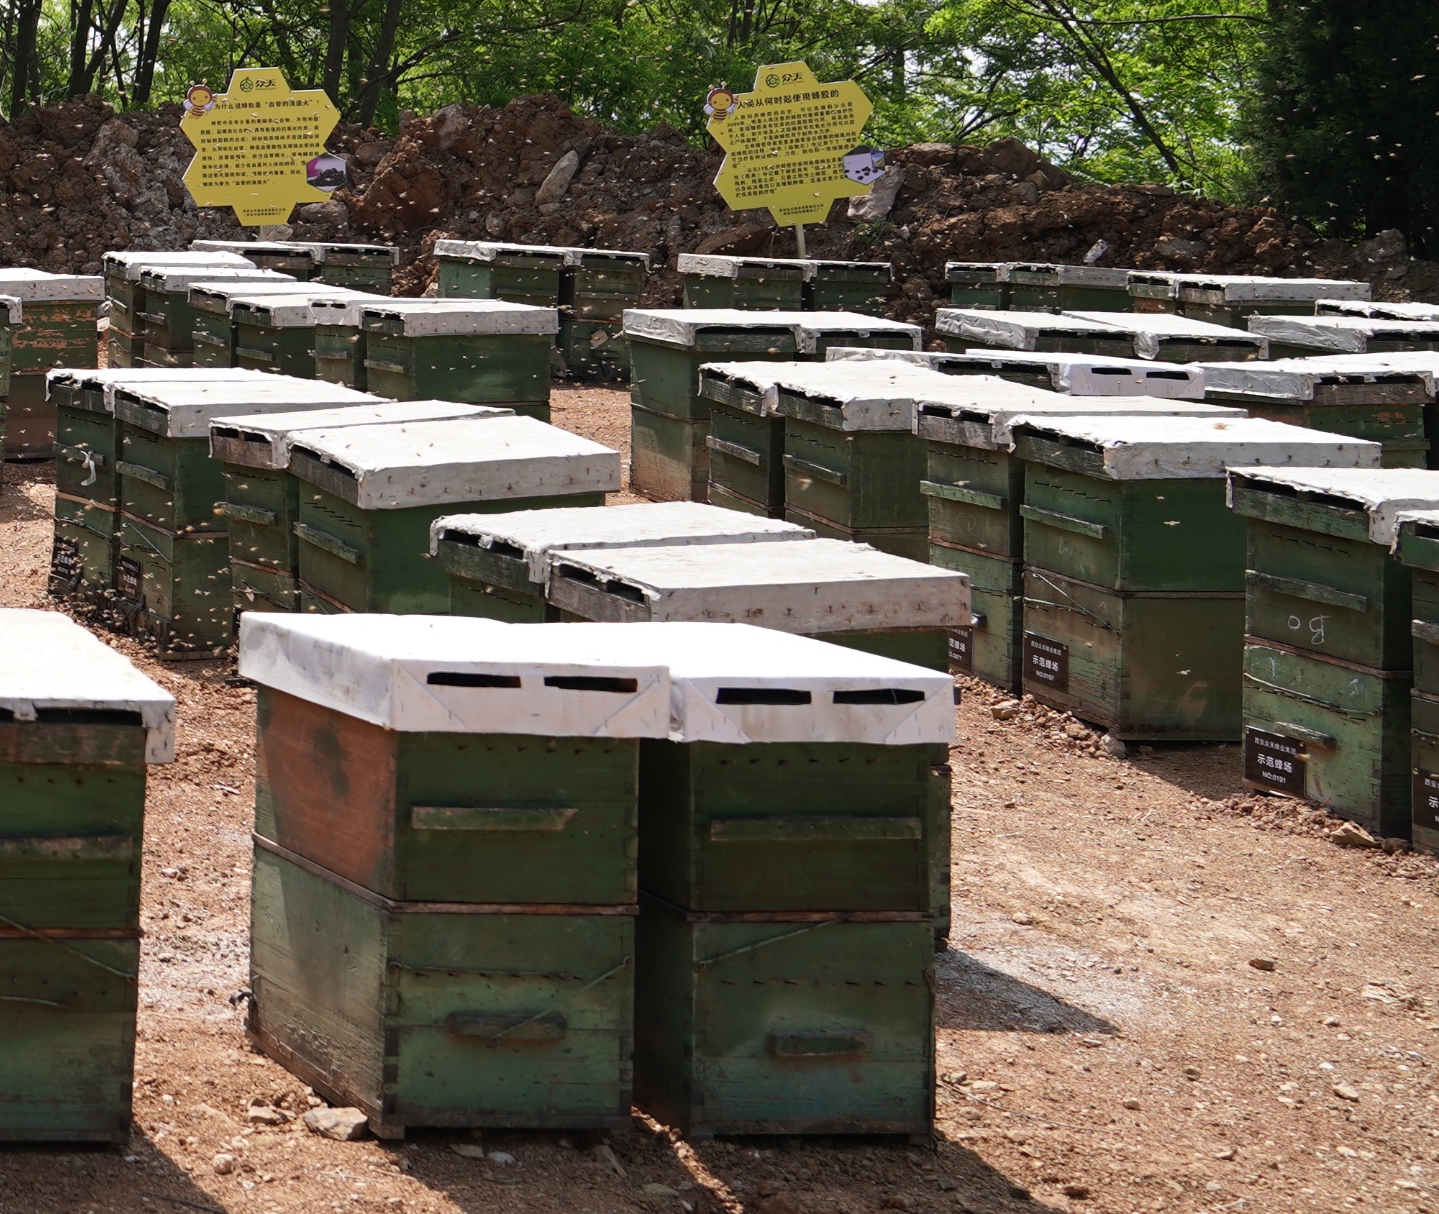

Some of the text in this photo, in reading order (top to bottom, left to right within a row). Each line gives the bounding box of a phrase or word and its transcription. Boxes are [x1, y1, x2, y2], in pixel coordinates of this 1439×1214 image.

[737, 89, 839, 109] 人类从何时起使用蜂胶的
[1031, 654, 1059, 672] 示范蜂场
[1254, 736, 1297, 756] 西安众天蜂业集团
[1256, 753, 1293, 774] 示范蜂场
